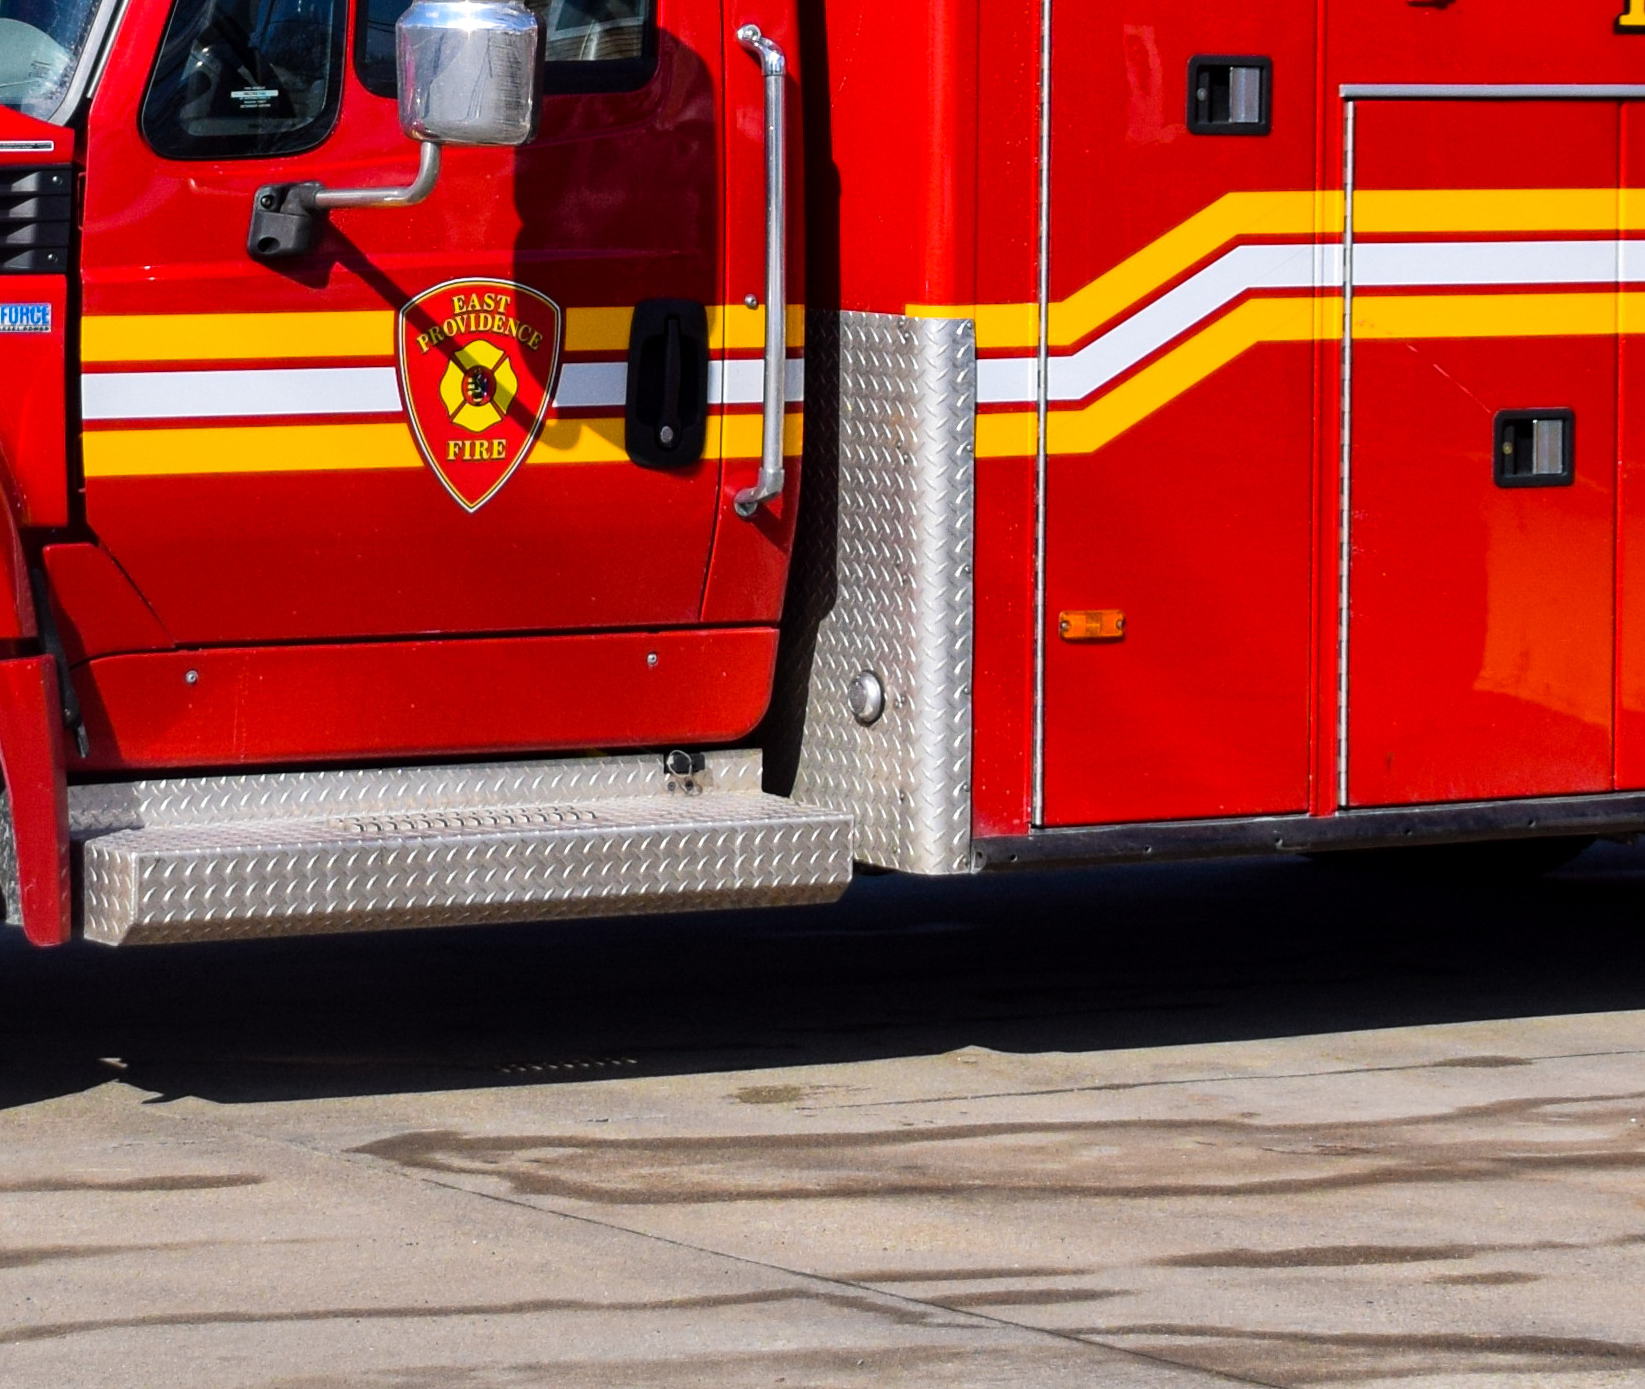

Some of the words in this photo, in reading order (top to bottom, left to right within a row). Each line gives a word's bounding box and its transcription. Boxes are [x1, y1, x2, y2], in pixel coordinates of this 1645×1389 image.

[452, 293, 511, 314] EAST
[416, 313, 543, 354] PROVIDENCE
[447, 439, 507, 461] FIRE
